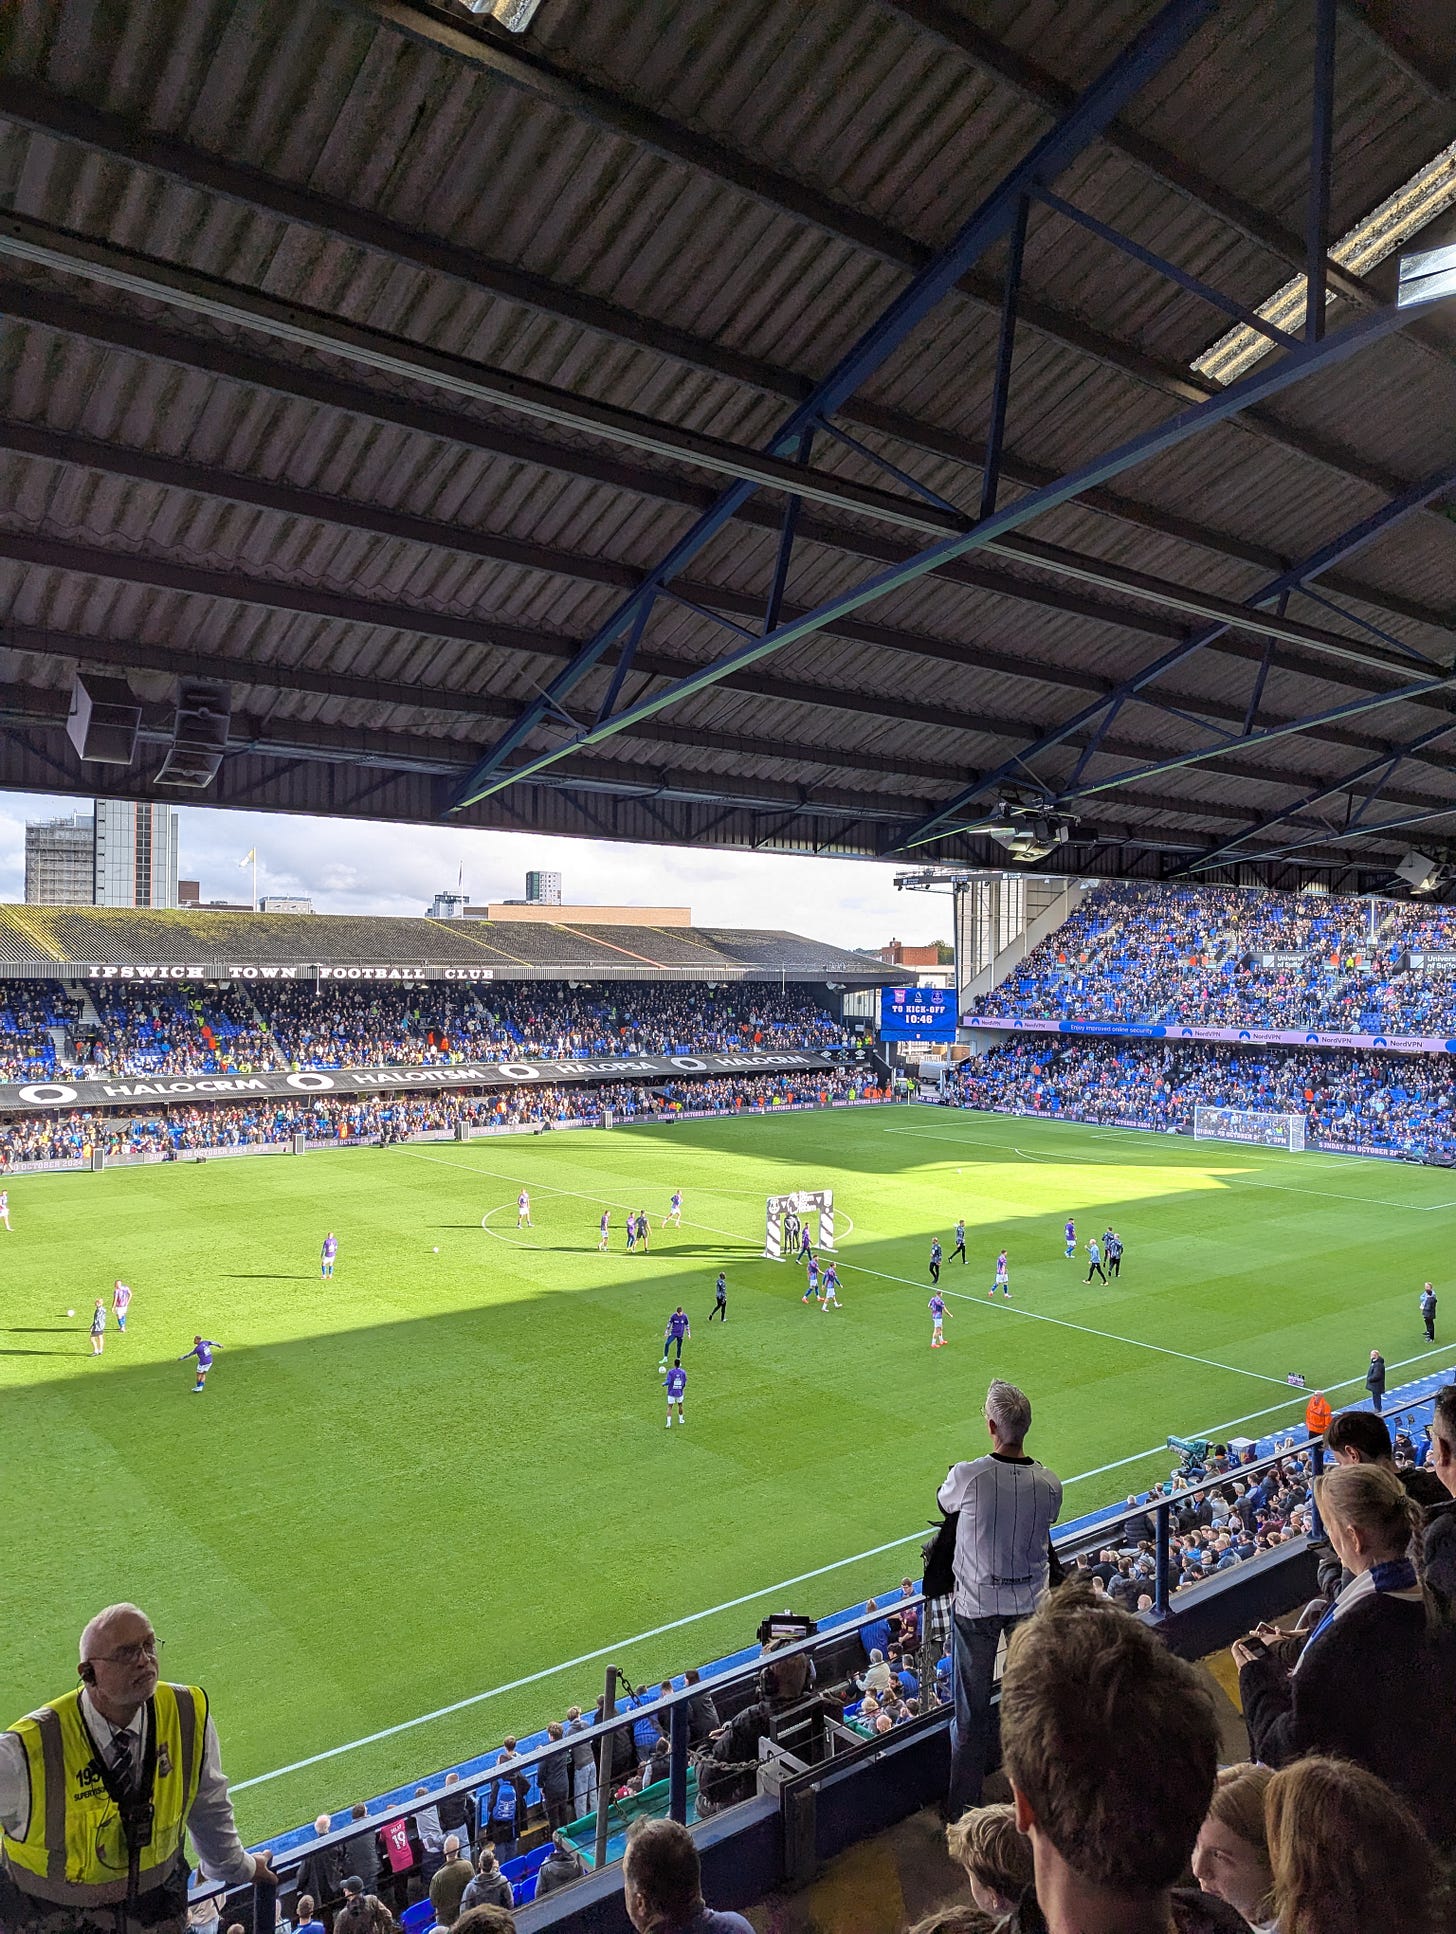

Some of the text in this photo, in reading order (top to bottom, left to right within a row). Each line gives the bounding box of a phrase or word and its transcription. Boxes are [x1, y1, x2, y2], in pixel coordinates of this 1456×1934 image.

[89, 966, 494, 979] IPSWICH TOWN FOOTBALL CLUB
[892, 1005, 946, 1014] TO KICK-OFF
[905, 1014, 933, 1024] 10:46
[1070, 1024, 1084, 1032] Enjoy
[1086, 1025, 1111, 1034] improved
[1130, 1027, 1153, 1035] security
[1322, 1036, 1352, 1044] NordVPN
[1390, 1040, 1423, 1048] NordVPN
[714, 1055, 811, 1067] HALOCRM
[555, 1061, 658, 1074] HALOPSA
[352, 1068, 485, 1085] HALOITSM
[103, 1078, 268, 1097] HALOCRM
[1357, 1146, 1388, 1156] OCTOBER
[21, 1160, 61, 1171] OCTOBER
[62, 1159, 83, 1169] 2024
[392, 1831, 406, 1850] 19
